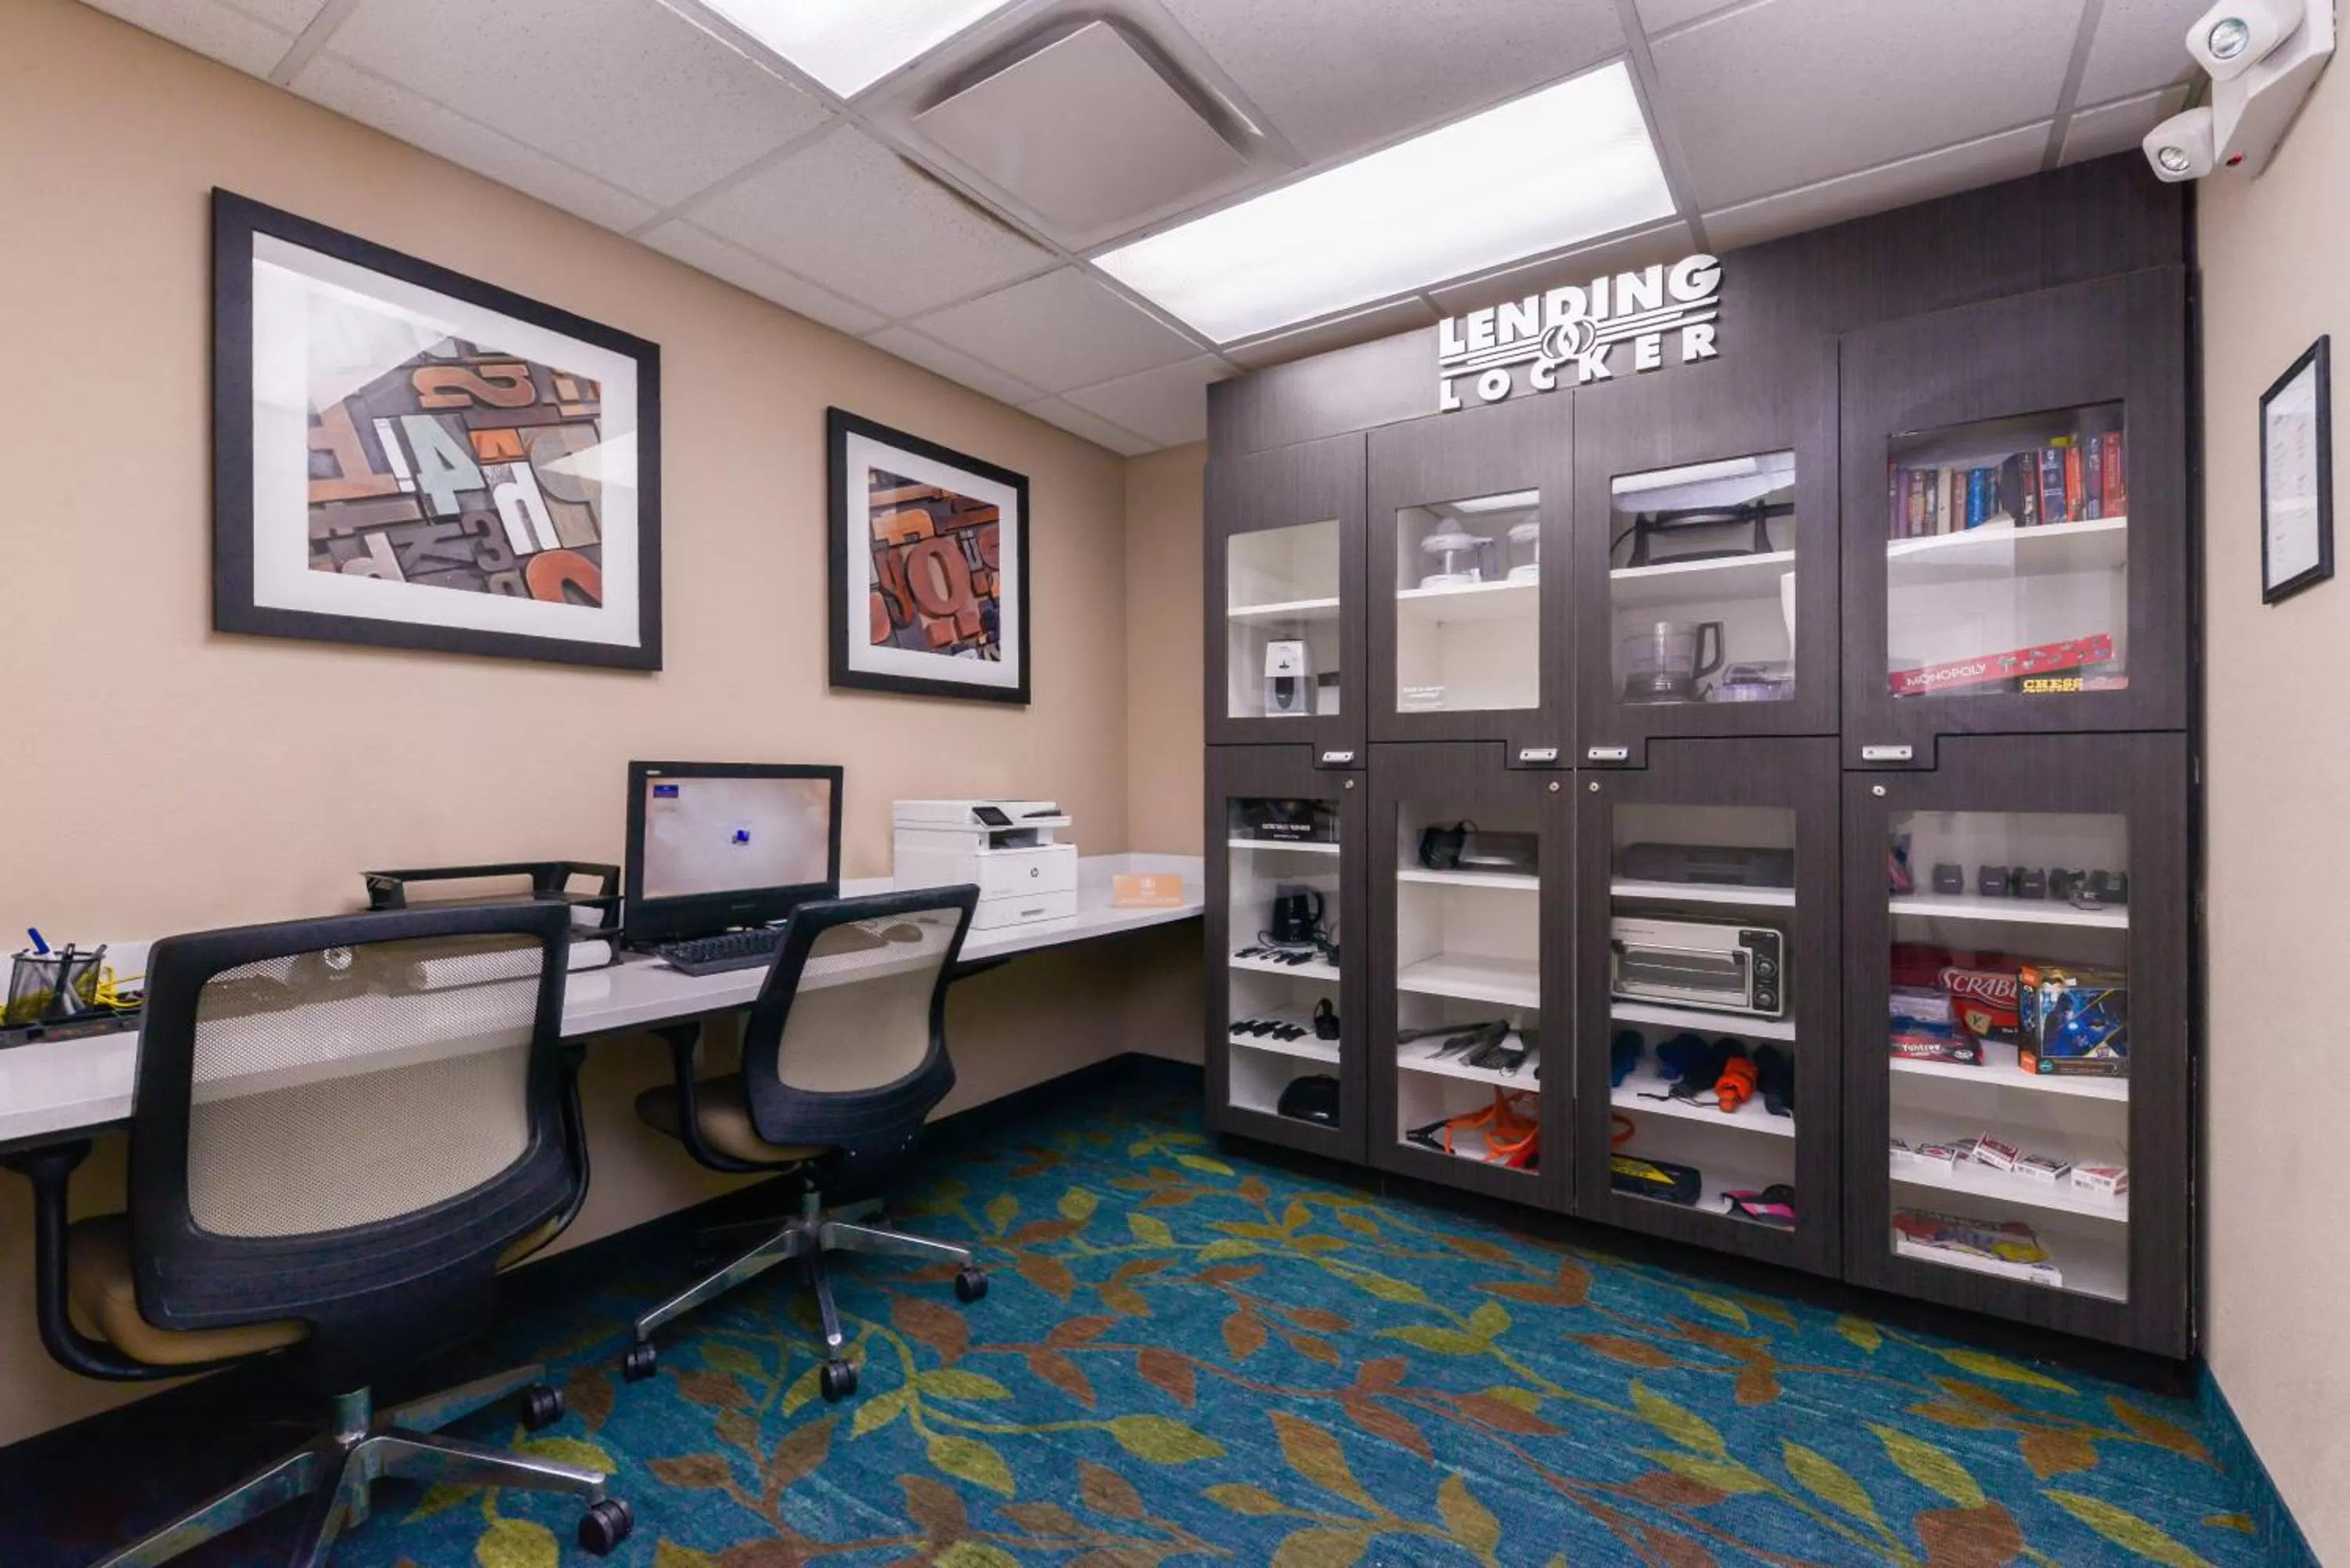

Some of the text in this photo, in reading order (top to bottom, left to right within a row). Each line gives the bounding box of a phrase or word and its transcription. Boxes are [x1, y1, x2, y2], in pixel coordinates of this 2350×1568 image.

[1439, 254, 1721, 357] LENDING
[1441, 323, 1718, 412] LOCKER
[1905, 663, 1986, 687] MONOPOLY
